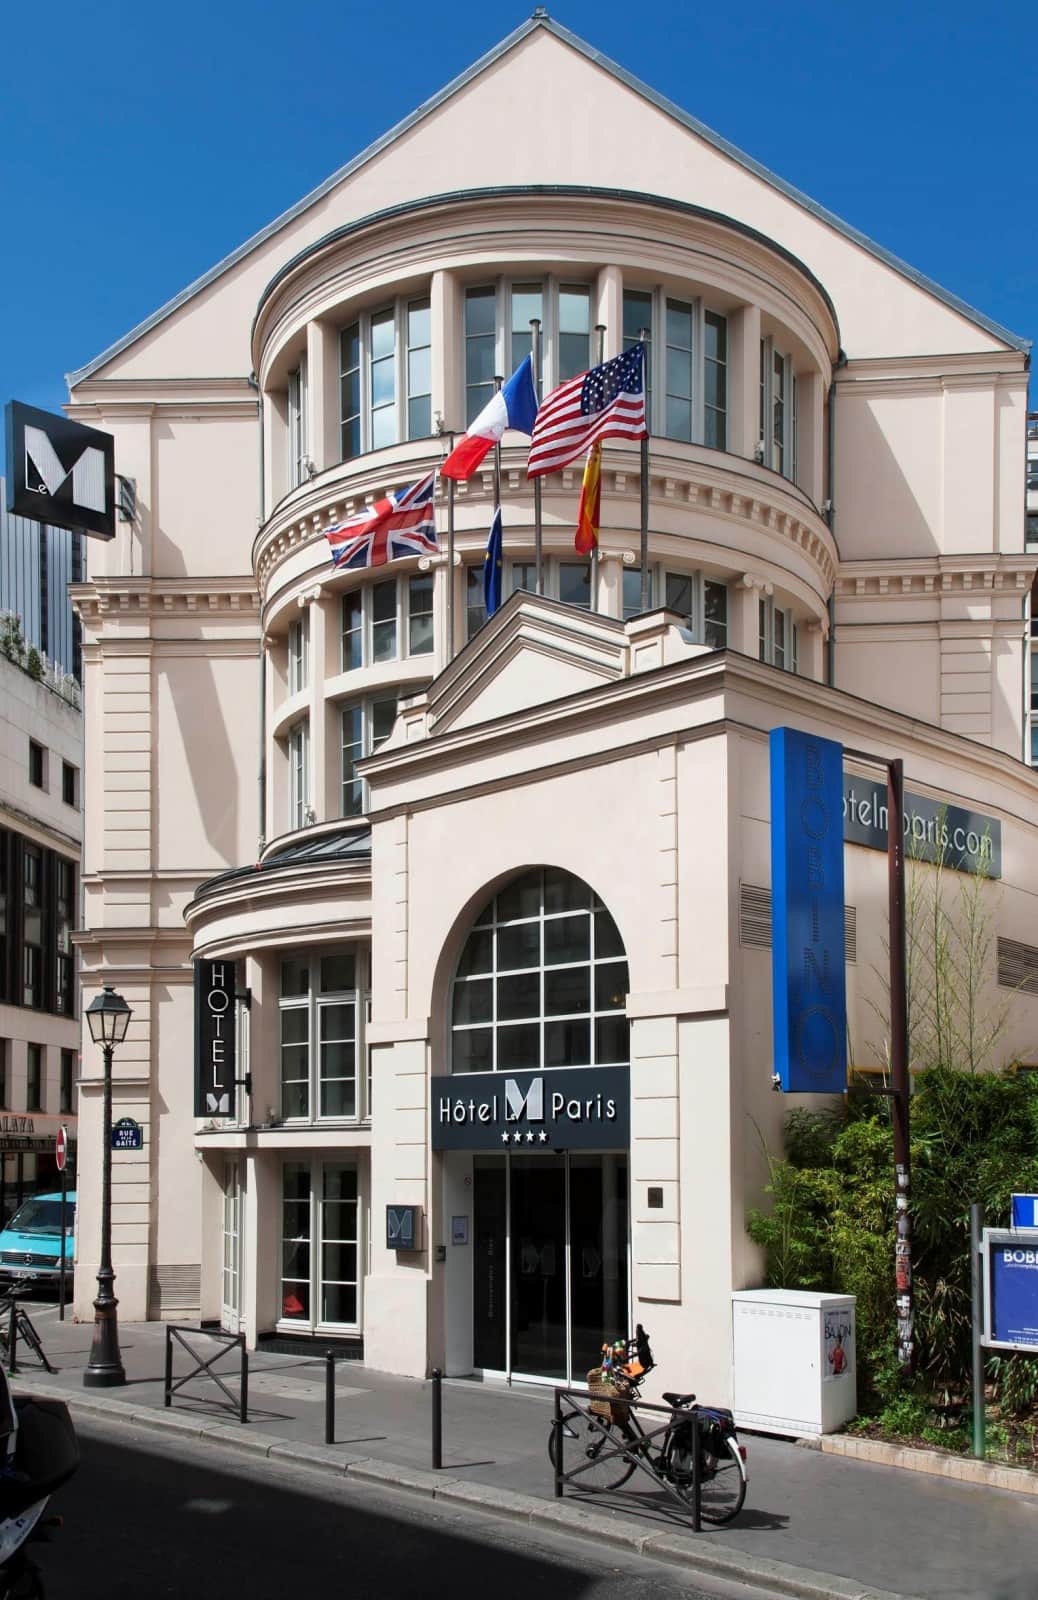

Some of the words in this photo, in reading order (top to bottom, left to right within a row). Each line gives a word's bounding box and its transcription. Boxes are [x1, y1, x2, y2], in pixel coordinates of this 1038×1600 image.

[24, 424, 106, 514] M
[843, 789, 993, 861] telmaris.com
[208, 963, 229, 1088] HOTEL
[440, 1095, 497, 1123] Hôtel
[505, 1077, 543, 1120] M
[552, 1092, 616, 1120] Paris
